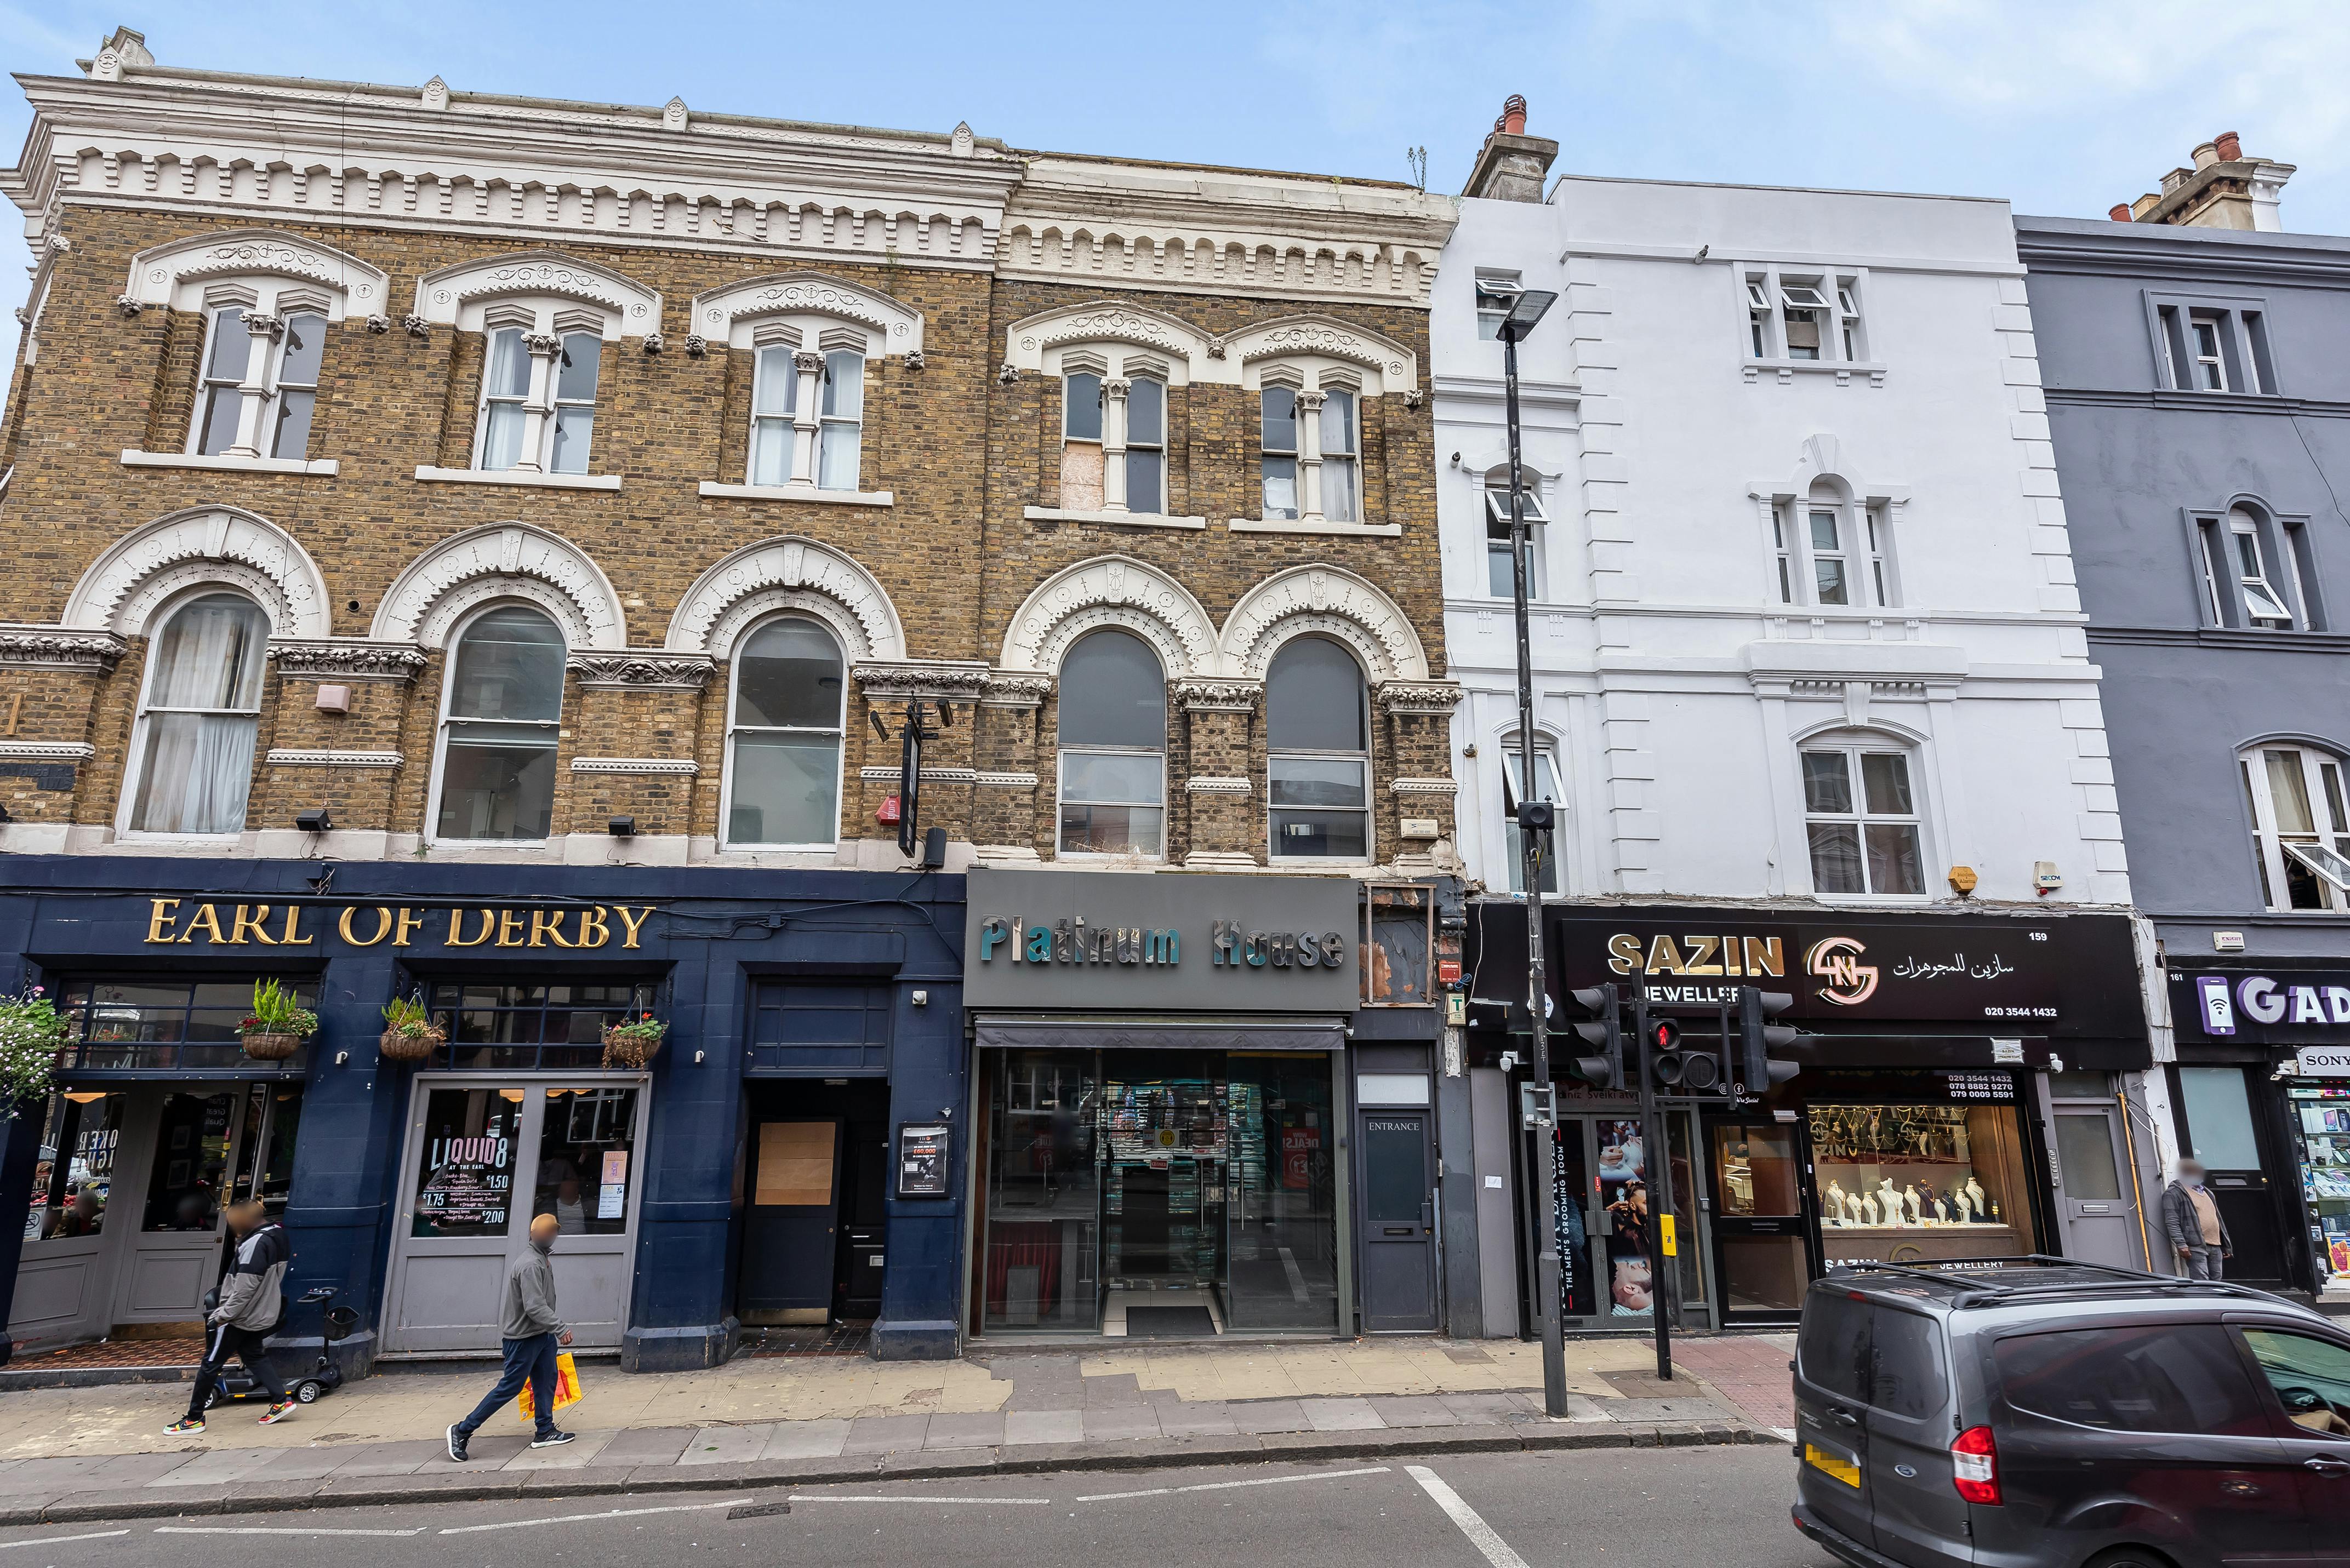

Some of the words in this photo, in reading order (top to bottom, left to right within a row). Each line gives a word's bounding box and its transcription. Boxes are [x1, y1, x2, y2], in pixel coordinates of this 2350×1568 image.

[144, 899, 313, 945] EARL
[339, 907, 423, 947] OF
[444, 906, 657, 948] DERBY
[980, 914, 1180, 964] Platinum
[1213, 919, 1344, 966] House
[2029, 932, 2047, 941] 159
[1607, 934, 1785, 977] SAZIN
[2170, 973, 2183, 981] 161
[2236, 976, 2350, 1023] GAD
[1984, 1007, 2003, 1016] 020
[2006, 1008, 2030, 1016] 3544
[2032, 1008, 2057, 1017] 1432
[2306, 1055, 2350, 1066] SONY
[1369, 1122, 1419, 1131] ENTRANCE
[430, 1137, 508, 1171] LIQUID8
[486, 1175, 509, 1189] £1.50
[423, 1193, 444, 1206] £1.75
[1559, 1180, 1569, 1234] GROOMING
[482, 1210, 504, 1223] £2.00
[1564, 1239, 1572, 1269] MEN'S
